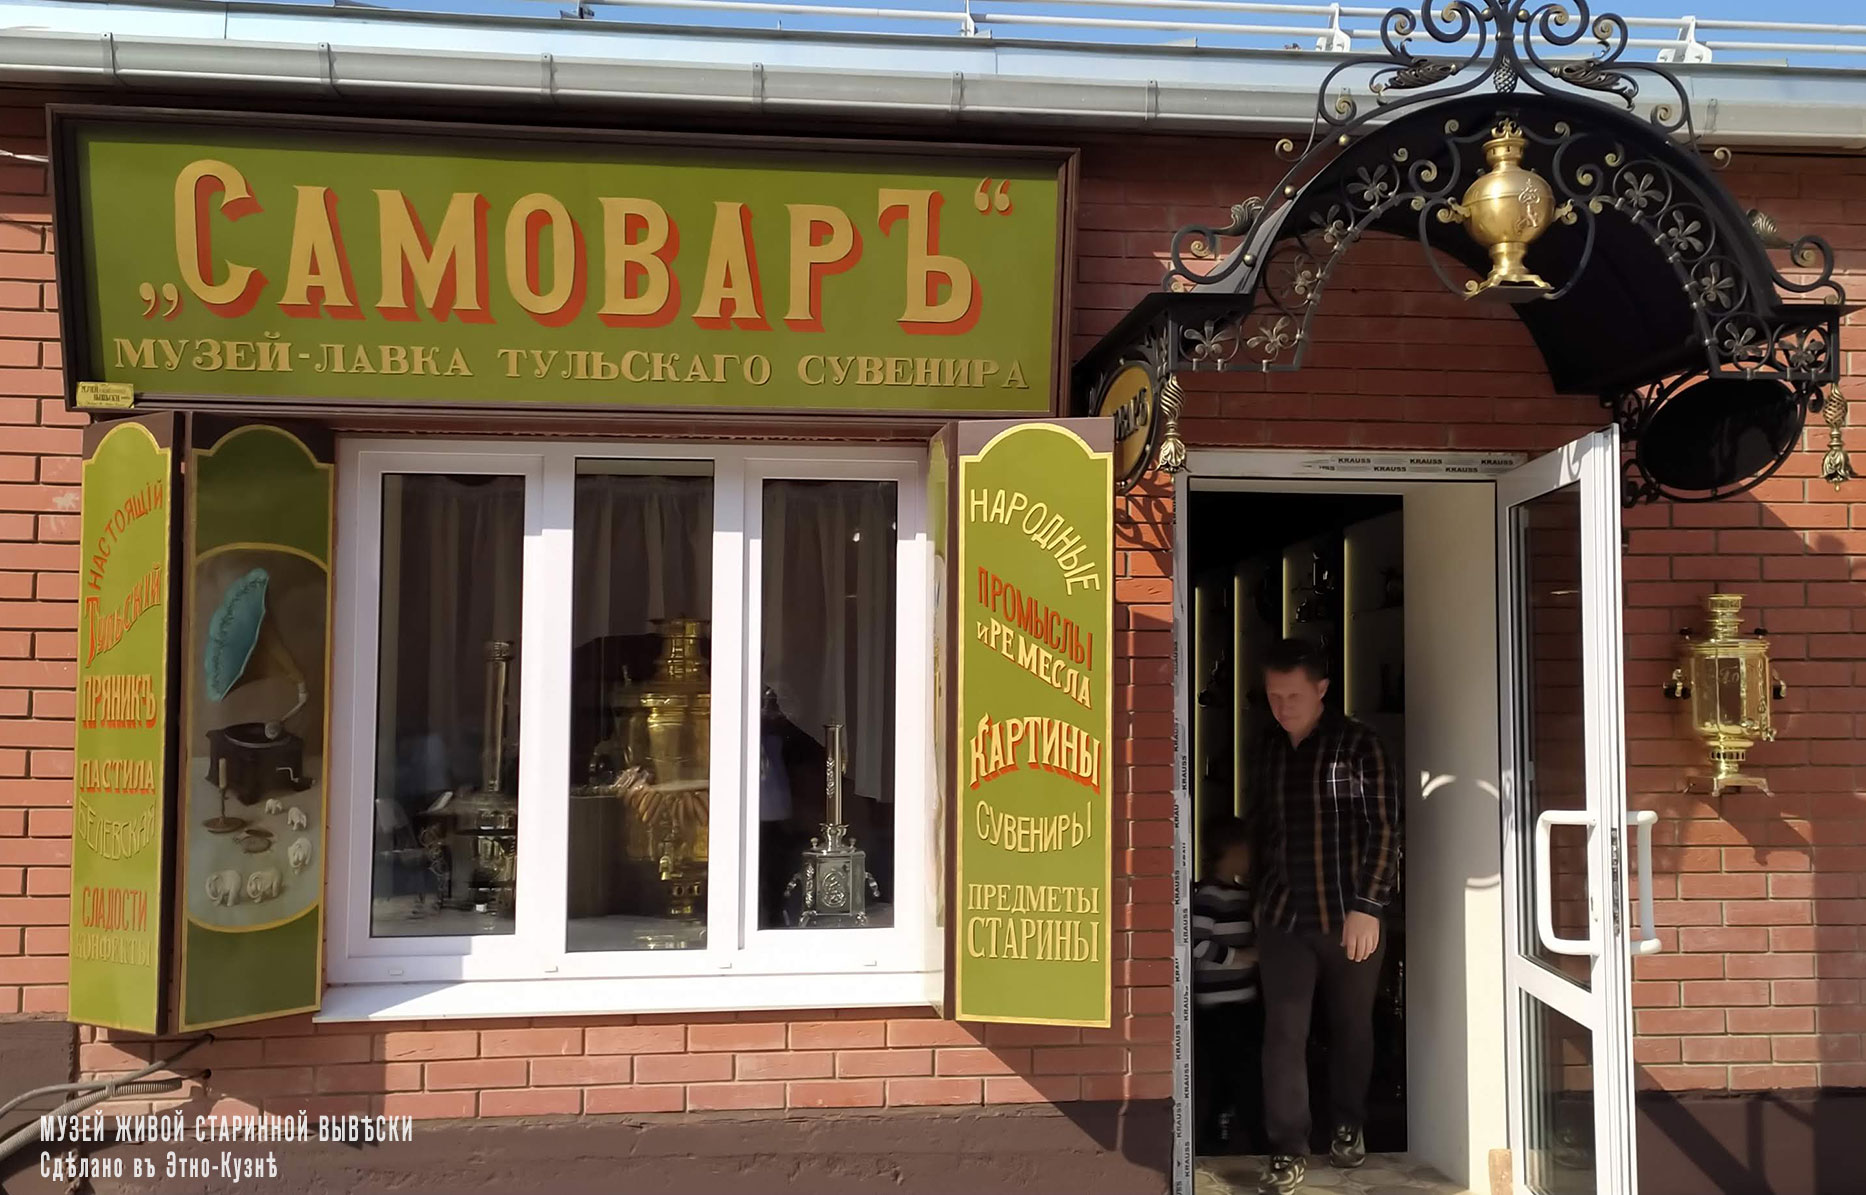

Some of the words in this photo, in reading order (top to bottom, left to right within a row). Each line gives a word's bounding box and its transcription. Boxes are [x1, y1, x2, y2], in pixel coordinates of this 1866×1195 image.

[113, 331, 474, 379] МУЗЕЙ-ЛАВКА
[498, 347, 772, 386] ТУЛЬСКАГО
[798, 354, 1030, 390] СУВЕНИРА
[970, 488, 1100, 596] НАРОДНЫЕ
[977, 565, 1093, 671] ПРОМЫСЛЫ
[83, 674, 158, 729] ПРЯНИКЪ
[79, 759, 156, 795] ПАСТИЛА
[969, 712, 1101, 796] КАРТИНЫ
[976, 800, 1092, 853] СУВЕНИРЫ
[82, 886, 147, 932] СЛАДОСТИ
[967, 883, 1100, 915] ПРЕДМЕТЫ
[967, 916, 1100, 963] СТАРИНЫ
